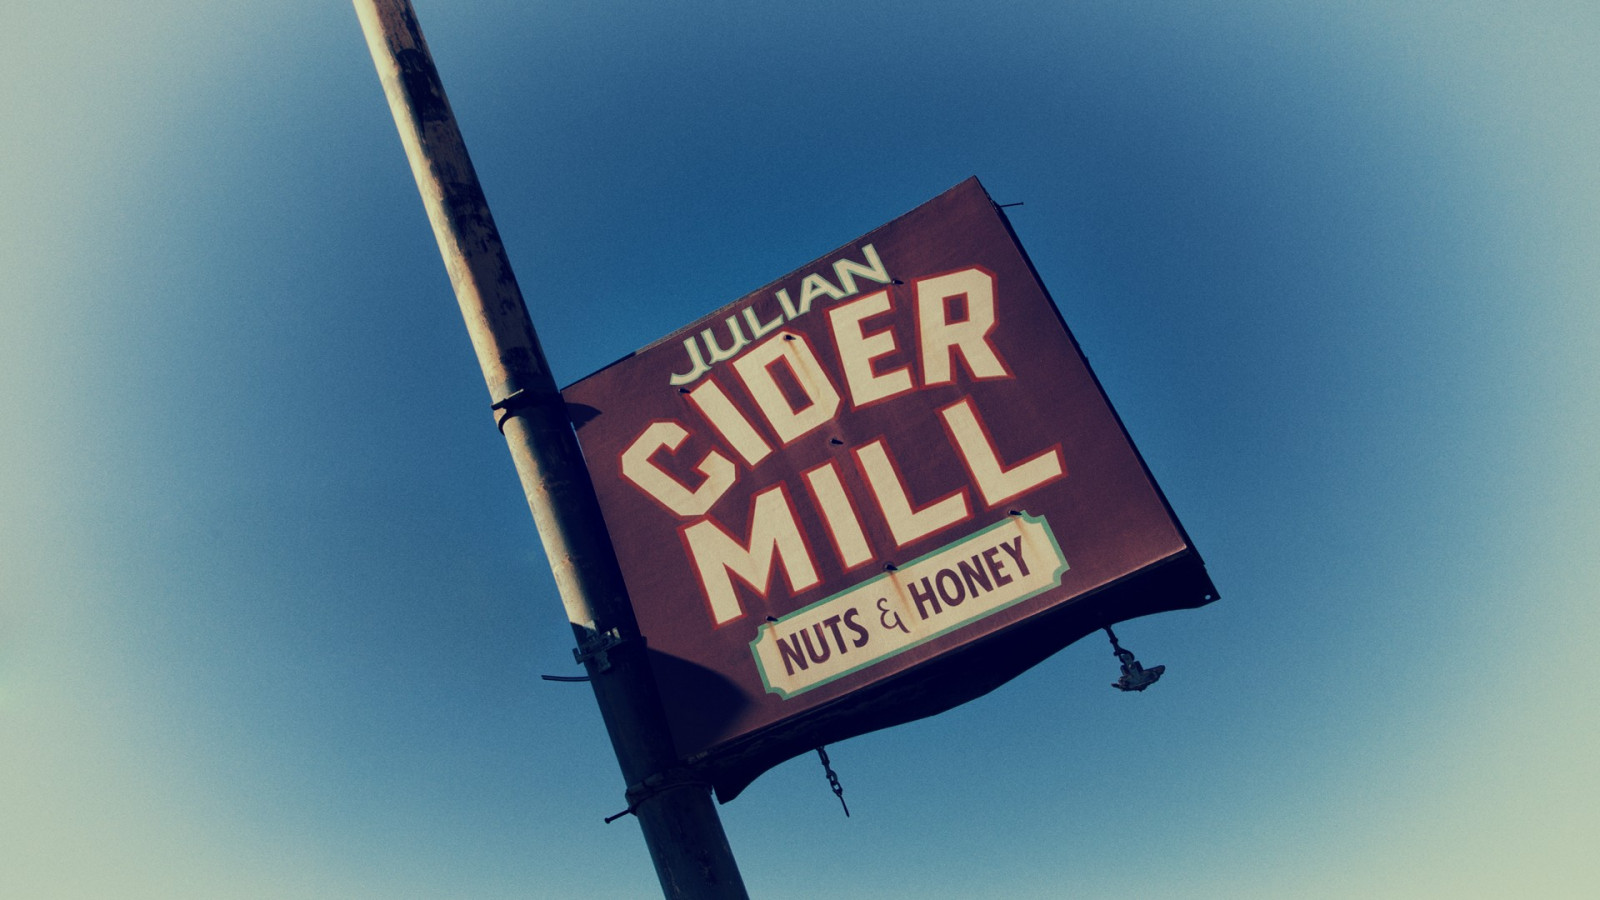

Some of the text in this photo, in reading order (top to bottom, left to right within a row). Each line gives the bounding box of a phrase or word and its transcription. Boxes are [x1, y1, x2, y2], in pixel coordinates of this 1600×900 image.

[620, 267, 1011, 517] CIDER
[670, 243, 892, 386] JULIAN
[681, 398, 1064, 626] MILL
[775, 535, 1031, 677] NUTS & HONEY
